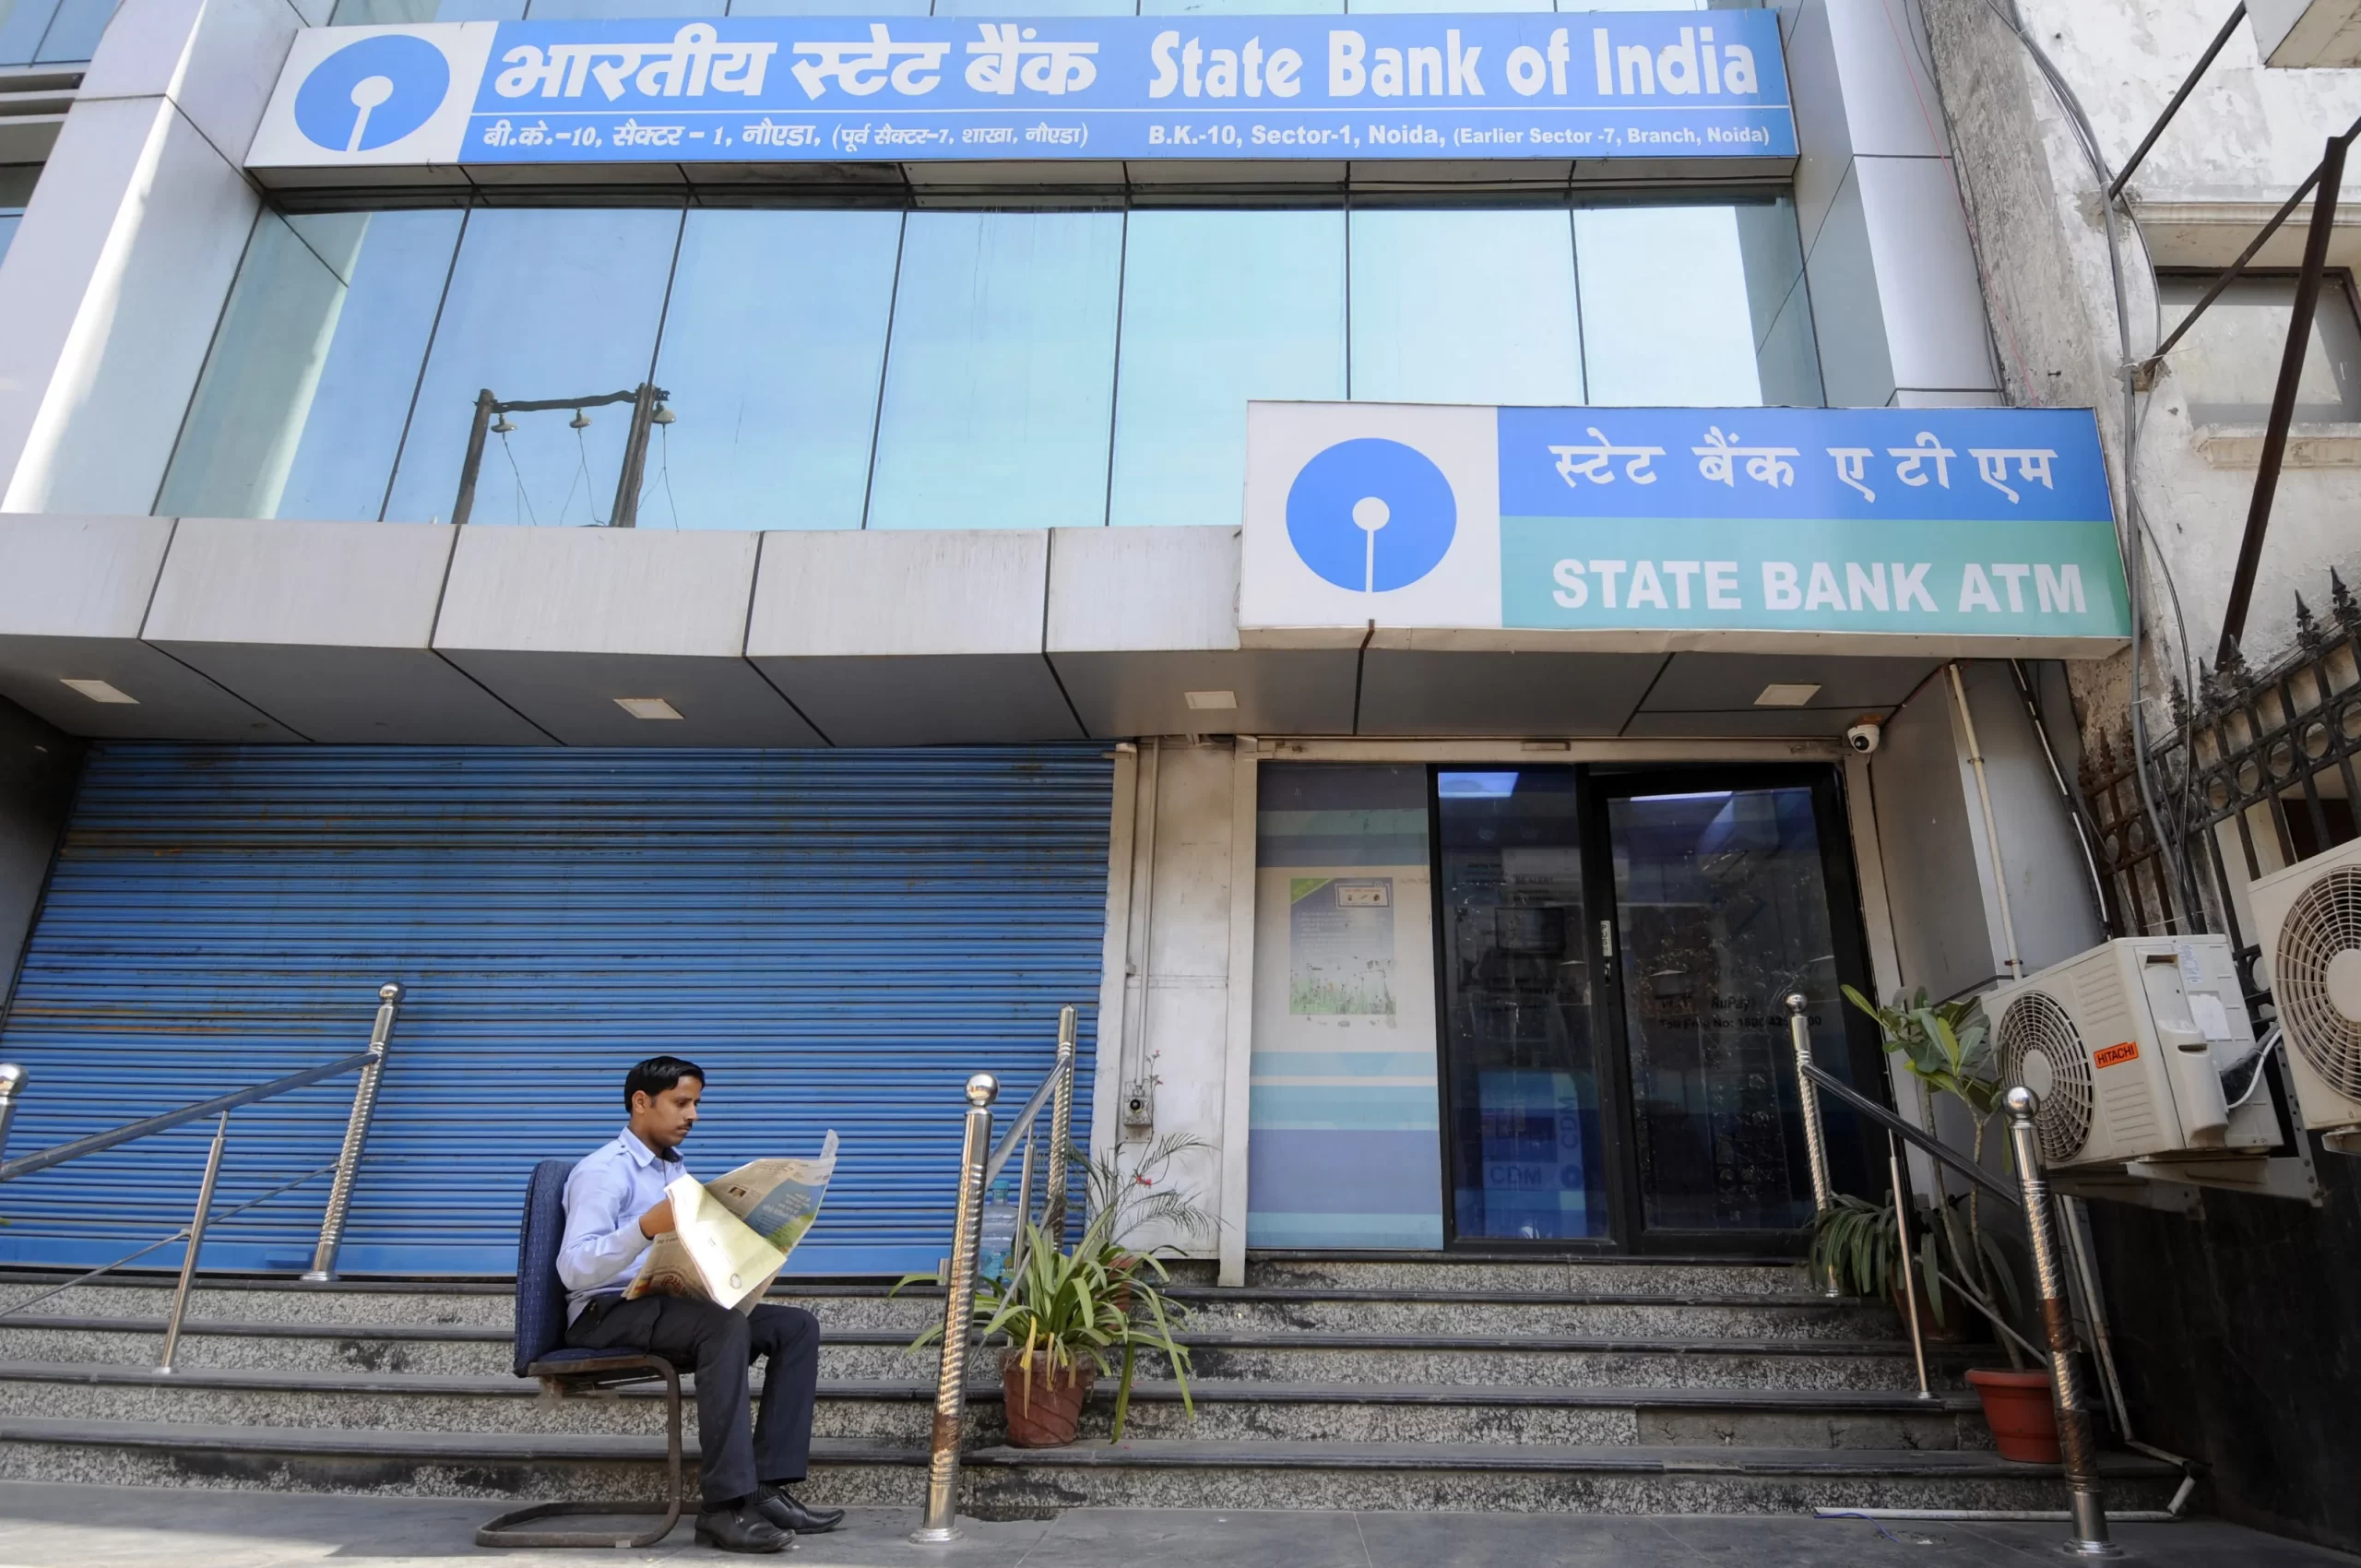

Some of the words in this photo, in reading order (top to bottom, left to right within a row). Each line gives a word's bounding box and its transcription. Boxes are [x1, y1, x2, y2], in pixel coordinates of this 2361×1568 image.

[494, 20, 777, 101] भारतीय
[791, 24, 951, 100] स्टेट
[966, 24, 1098, 94] बैंक
[1149, 30, 1302, 98] State
[1329, 30, 1485, 97] Bank
[1507, 29, 1570, 96] of
[1594, 27, 1757, 95] India
[613, 118, 685, 146] सैक्टर
[742, 117, 820, 147] नौएडा,
[833, 124, 871, 152] (पूर्व
[962, 128, 1017, 144] शाखा,
[1026, 122, 1088, 148] नौएडा)
[1149, 125, 1241, 148] B.K.-10,
[1252, 125, 1359, 148] Sector-1,
[1370, 125, 1445, 148] Noida,
[1453, 128, 1524, 147] (Earlier
[1530, 128, 1592, 143] Sector
[1598, 128, 1621, 147] -7,
[1628, 127, 1701, 146] Branch,
[1707, 126, 1768, 145] Noida)
[1548, 428, 1666, 487] स्टेट
[1691, 426, 1800, 488] बैंक
[1826, 448, 1875, 503] ए
[1887, 432, 1956, 488] टी
[1968, 449, 2058, 504] एम
[1553, 559, 1741, 609] STATE
[1762, 562, 1939, 612] BANK
[1958, 564, 2086, 612] ATM
[2097, 1045, 2135, 1064] HITACHI
[1490, 1166, 1541, 1185] CDM
